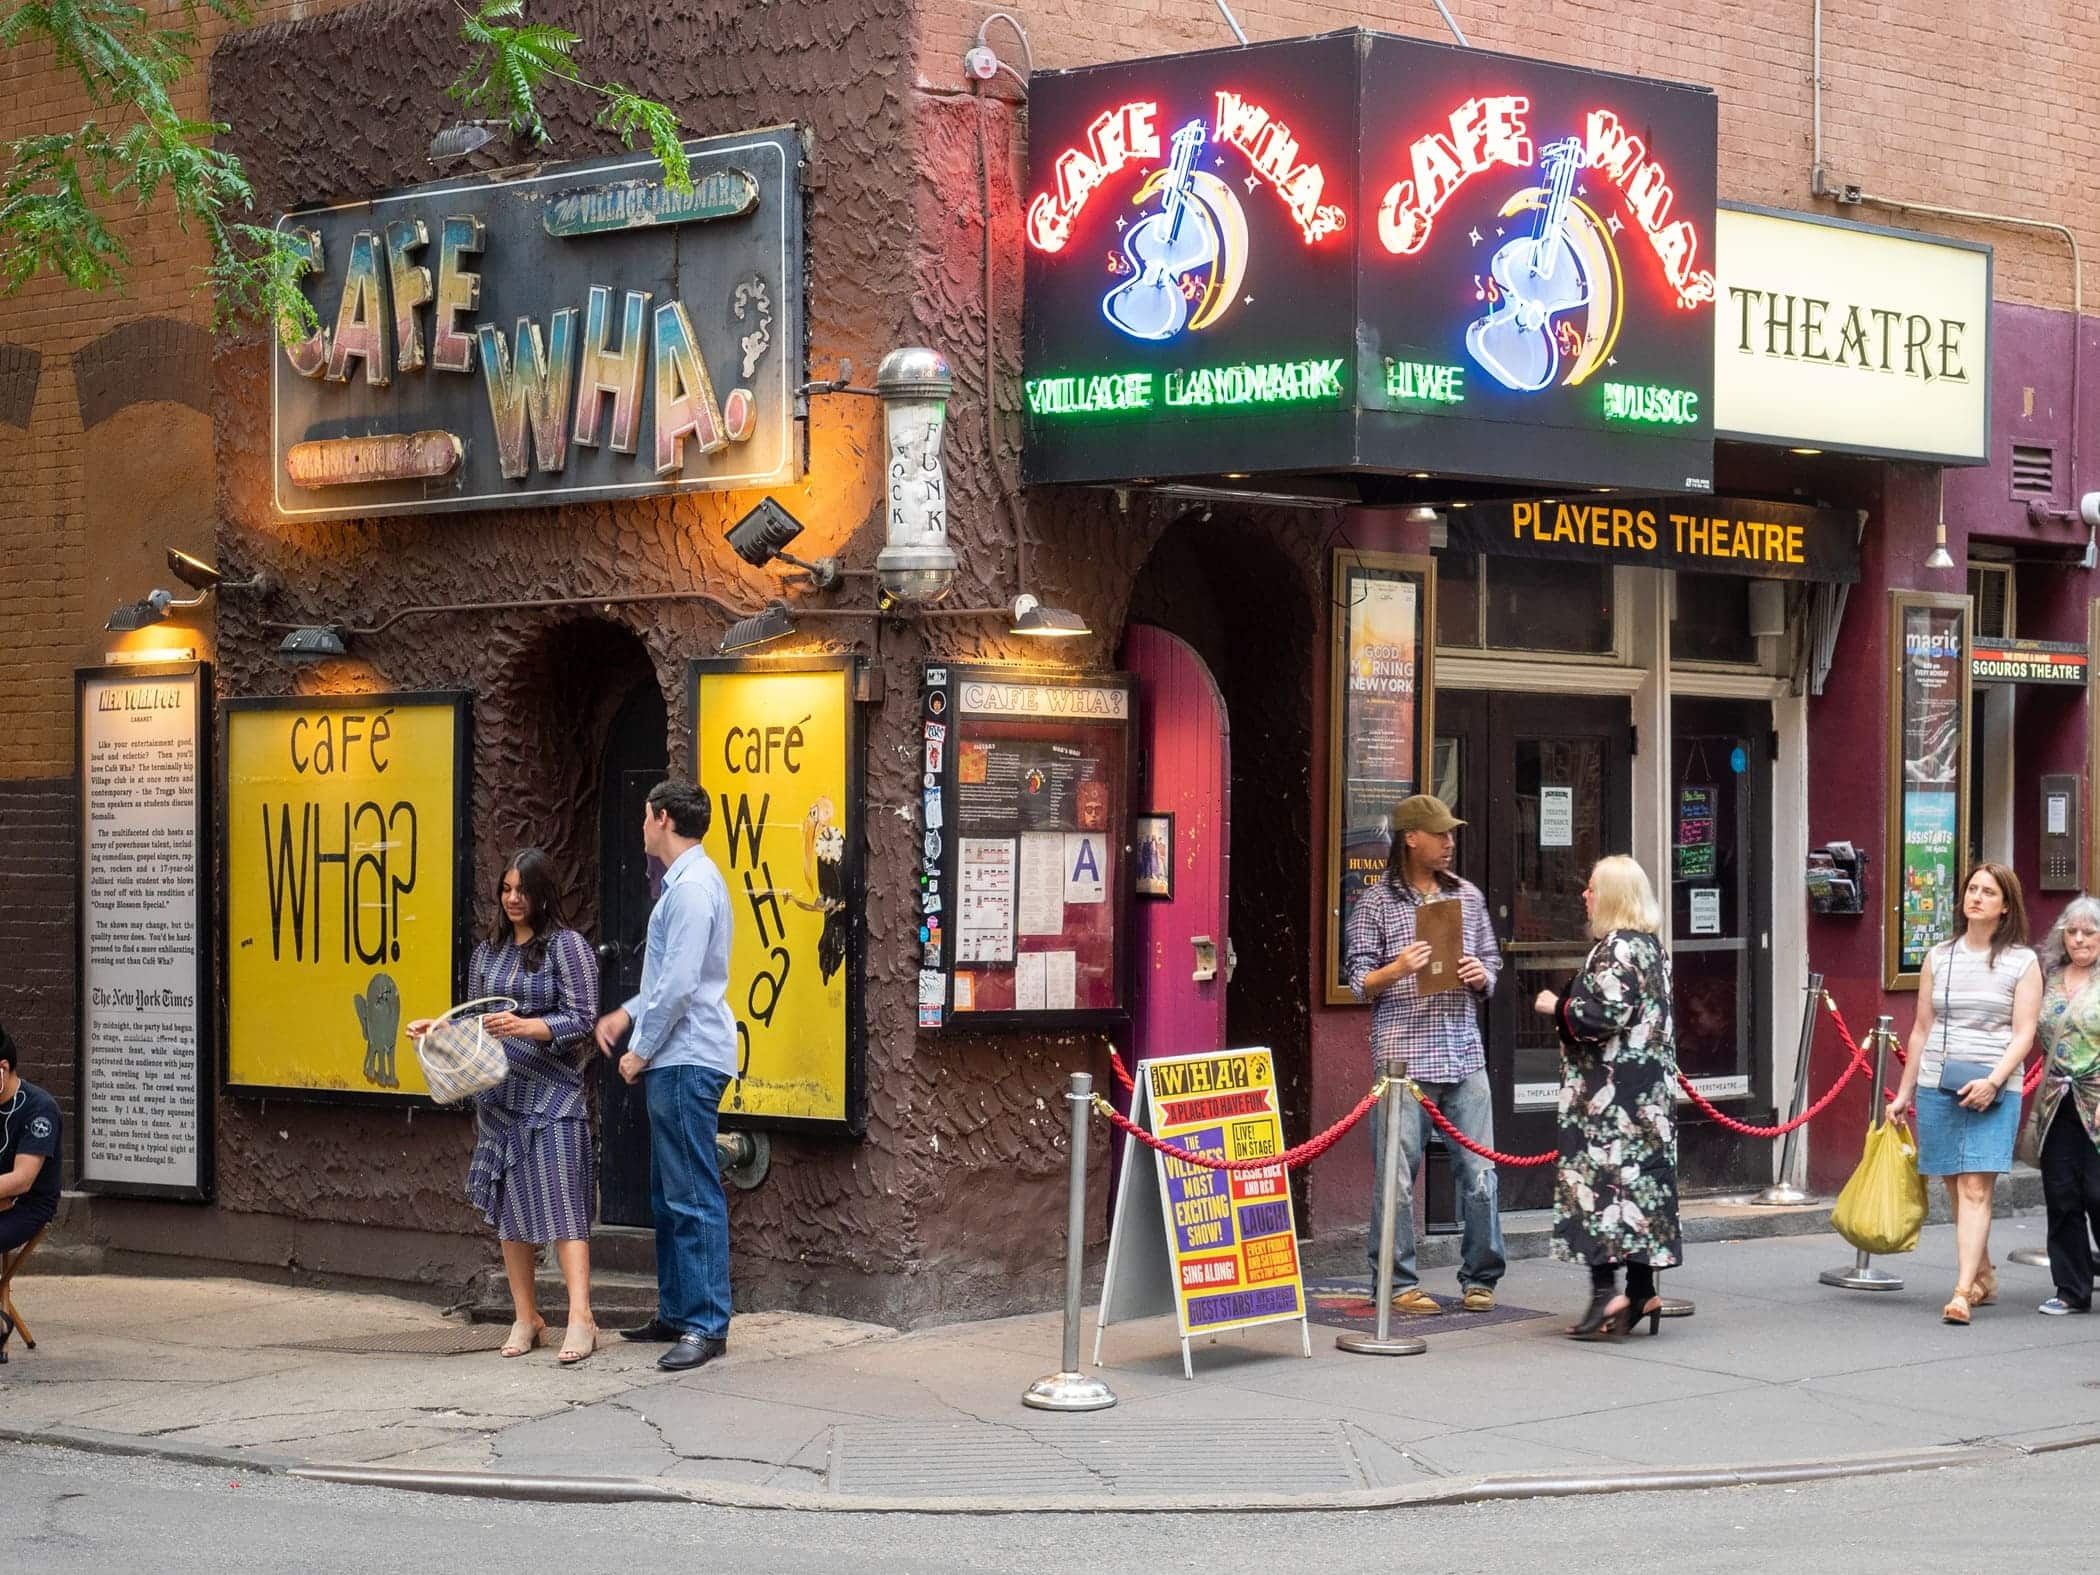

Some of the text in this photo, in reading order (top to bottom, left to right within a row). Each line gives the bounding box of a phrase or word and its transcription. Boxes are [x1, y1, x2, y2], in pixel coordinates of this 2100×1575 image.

[1028, 91, 1346, 252] CAFE WHA?
[1378, 95, 1533, 253] CAFE
[285, 213, 488, 389] CAFE
[1728, 287, 1969, 387] THEATRE
[1026, 358, 1344, 413] VILLAGE LANDMARK
[1386, 361, 1464, 401] LIVE
[1603, 382, 1699, 424] MUSIC
[1512, 502, 1805, 563] PLAYERS THEATRE
[1365, 646, 1400, 659] GOOD
[1351, 658, 1415, 677] MORNING
[1973, 660, 2081, 680] SGOUROS THEATRE
[1350, 677, 1414, 693] NEW YORK
[966, 685, 1124, 715] CAFE WHA?
[98, 740, 111, 748] Like
[131, 739, 174, 747] entertainment
[123, 752, 148, 760] eclectic?
[158, 751, 172, 759] Then
[91, 776, 112, 785] Village
[152, 764, 181, 772] terminally
[91, 788, 132, 796] contemporary
[110, 865, 132, 873] rockers
[1072, 839, 1101, 882] A
[92, 988, 194, 1011] The New York Times
[1161, 1059, 1247, 1095] WHA?
[1170, 1093, 1263, 1121] A PLACE TO HAVE FUN
[1184, 1136, 1201, 1151] THE
[1235, 1125, 1255, 1141] LIVE!
[1237, 1140, 1273, 1156] ON STAGE
[1233, 1163, 1282, 1182] CLASSIC ROCK
[1183, 1174, 1215, 1199] MOST
[1244, 1180, 1260, 1196] AND
[1176, 1193, 1229, 1227] EXCITING
[1239, 1203, 1289, 1236] LAUGH!
[1187, 1221, 1223, 1246] SHOW!
[1182, 1259, 1236, 1284] SING ALONG!
[1189, 1299, 1219, 1322] GUEST
[1219, 1293, 1255, 1317] STARS!
